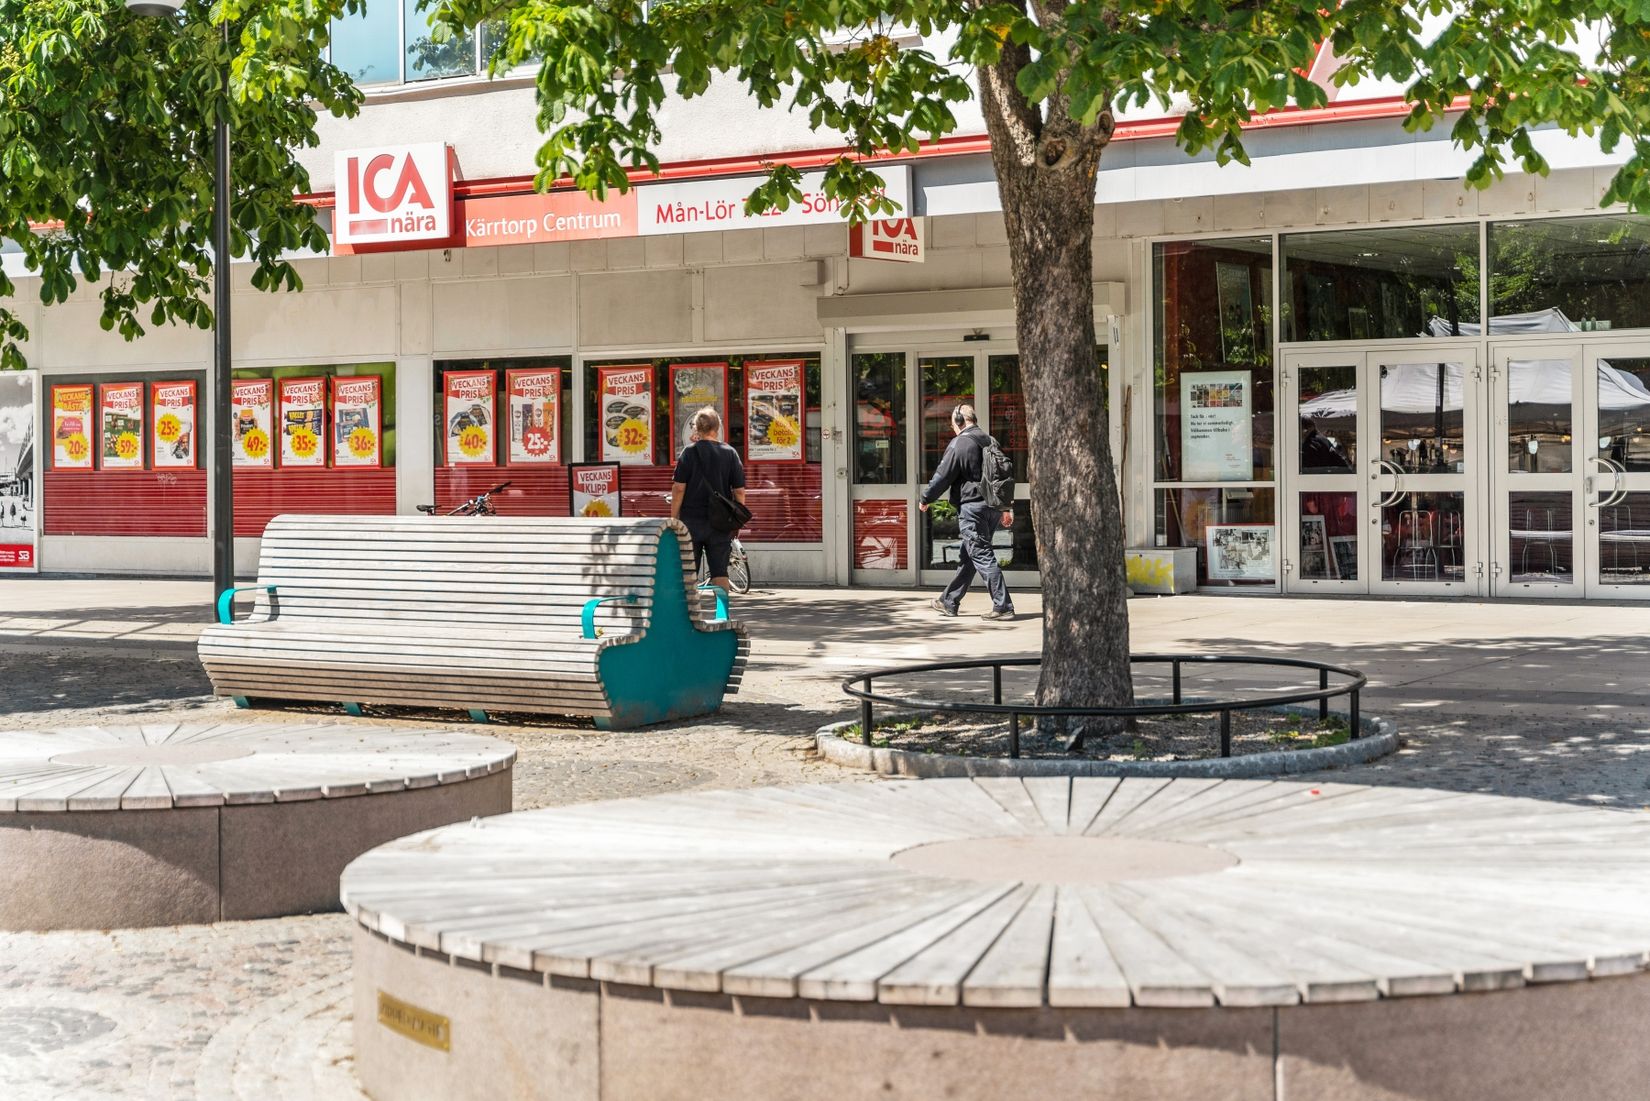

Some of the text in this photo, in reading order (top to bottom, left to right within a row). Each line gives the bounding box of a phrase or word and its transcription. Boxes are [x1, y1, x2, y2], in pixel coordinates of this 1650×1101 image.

[347, 152, 435, 214] ICA
[656, 201, 736, 225] Mån-Lör
[802, 193, 839, 214] Sön
[391, 211, 436, 233] nära
[466, 211, 621, 238] Kärrtorp Centrum
[895, 240, 919, 255] nära
[608, 373, 644, 385] VECKANS
[754, 368, 794, 380] VECKANS
[453, 378, 486, 389] VECKANS
[517, 376, 550, 388] VECKANS
[764, 380, 784, 390] PRIS
[160, 388, 188, 398] VECKANS
[236, 386, 265, 396] VECKANS
[286, 384, 317, 394] VECKANS
[340, 383, 371, 394] VECKANS
[524, 388, 542, 397] PRIS
[617, 386, 635, 395] PRIS
[107, 389, 136, 400] VECKANS
[347, 395, 363, 403] PRIS
[460, 390, 478, 398] PRIS
[114, 400, 128, 409] PRIS
[167, 399, 181, 407] PRIS
[242, 397, 258, 405] PRIS
[292, 395, 308, 404] PRIS
[580, 471, 612, 482] VECKANS
[584, 484, 607, 494] KLIPP
